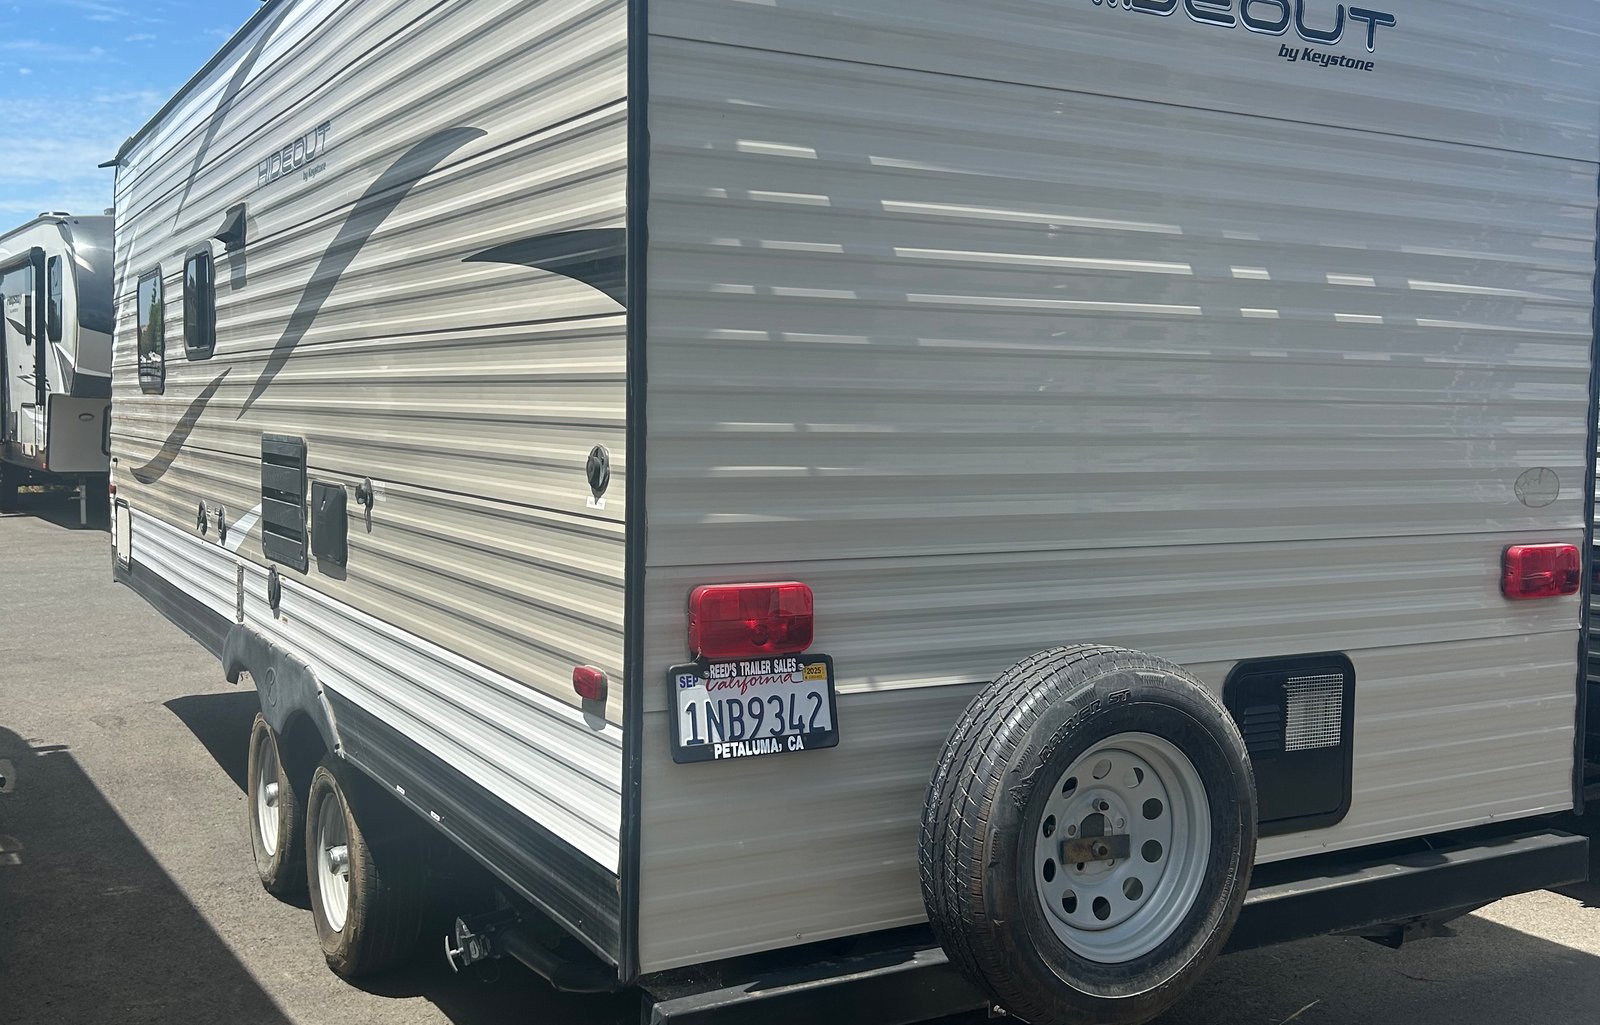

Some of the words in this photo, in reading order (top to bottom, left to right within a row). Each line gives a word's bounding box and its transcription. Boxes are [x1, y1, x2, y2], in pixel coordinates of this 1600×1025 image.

[1092, 0, 1396, 53] EOUT
[1278, 44, 1299, 62] by
[1301, 47, 1375, 72] Keystone
[257, 120, 331, 187] HIDEOUT
[709, 662, 737, 679] REED'S
[740, 660, 771, 676] TRAILER
[773, 657, 797, 674] SALES
[806, 666, 822, 675] 2025
[680, 675, 699, 689] SEP
[685, 691, 826, 746] 1NB9342
[714, 736, 782, 760] PETALUMA,
[787, 735, 804, 751] CA
